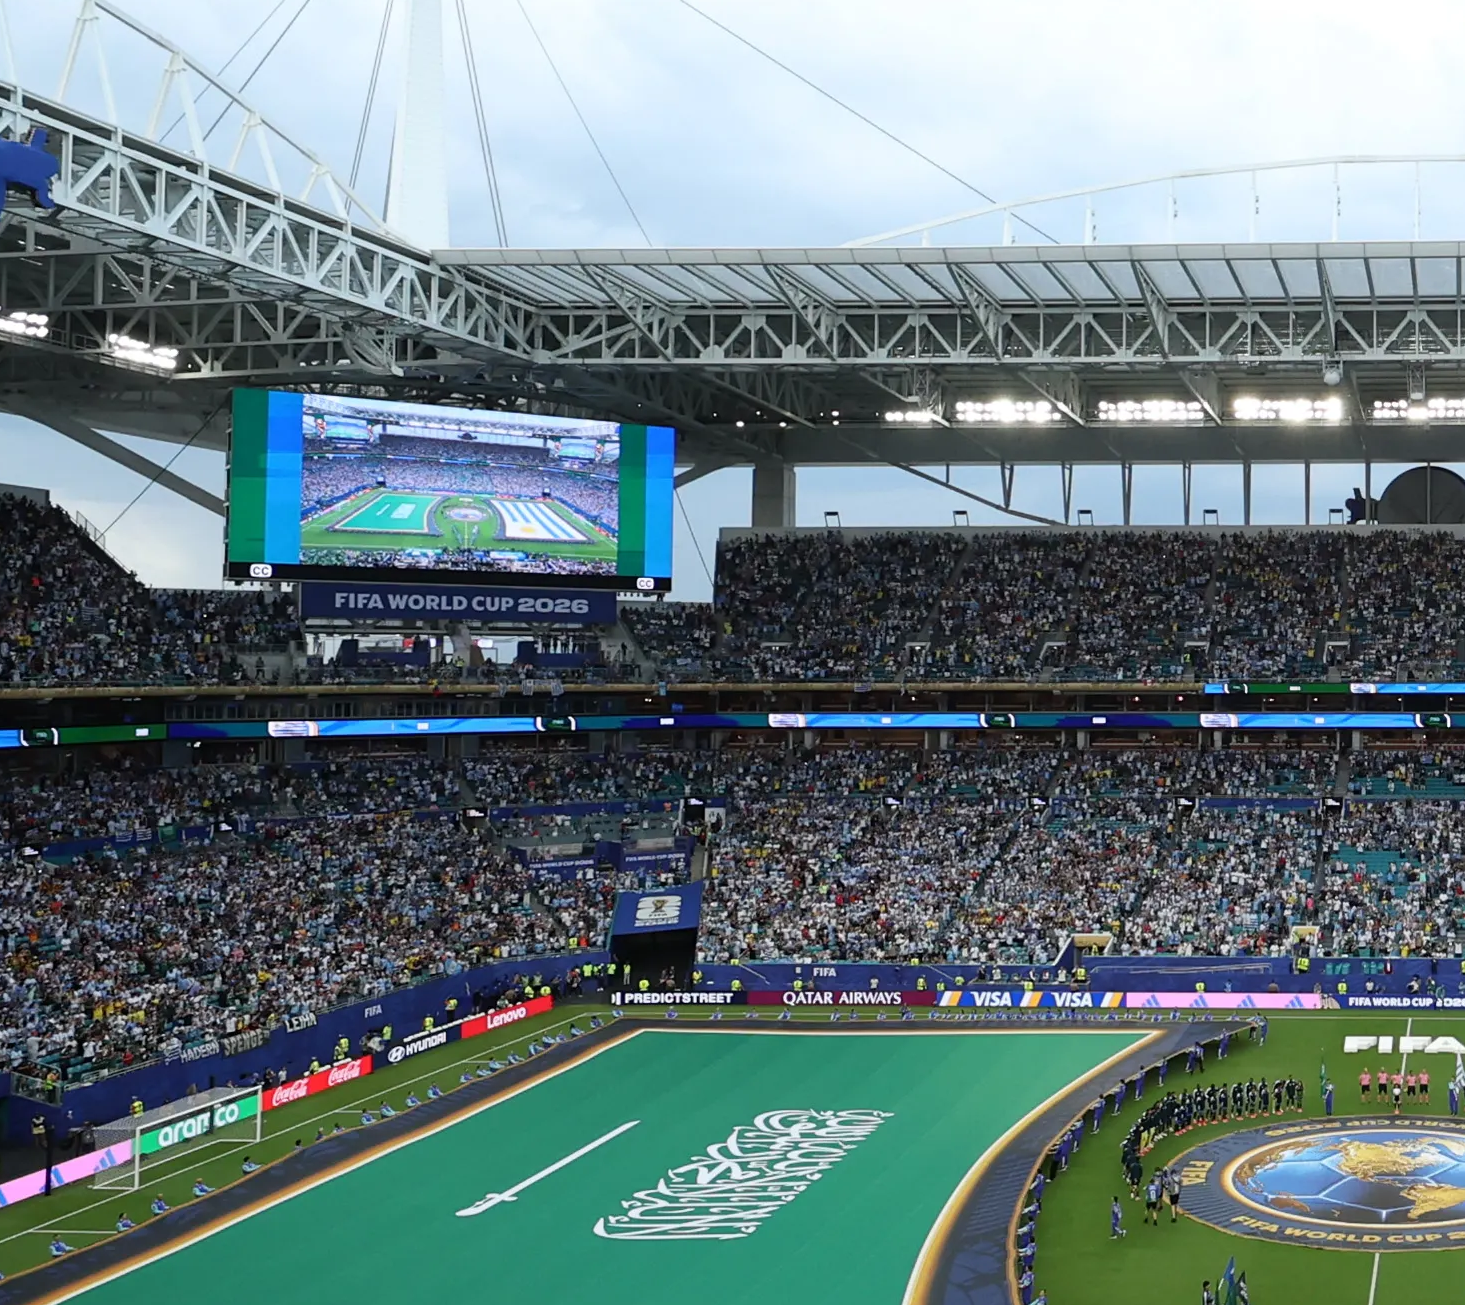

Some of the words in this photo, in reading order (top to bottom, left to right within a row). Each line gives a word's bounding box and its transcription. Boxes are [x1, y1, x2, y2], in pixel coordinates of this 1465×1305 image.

[252, 565, 271, 576] CC
[334, 592, 383, 610] FIFA
[386, 593, 468, 612] WORLD
[471, 596, 514, 613] CUP
[517, 597, 590, 615] 2026
[813, 967, 837, 977] FIFA
[625, 992, 733, 1005] PREDICTSTREET
[783, 991, 835, 1006] QATAR
[838, 991, 902, 1005] AIRWAYS
[971, 991, 1012, 1007] VISA
[1051, 991, 1093, 1007] VISA
[1348, 996, 1371, 1007] FIFA
[1372, 996, 1411, 1007] WORLD
[1412, 997, 1433, 1007] CUP
[365, 1004, 383, 1019] FIFA
[487, 1007, 527, 1029] Lenovo
[405, 1031, 446, 1056] HYUNDAI
[1230, 1214, 1279, 1234] FIFA
[1283, 1225, 1383, 1243] WORLD
[1386, 1228, 1443, 1243] CUP
